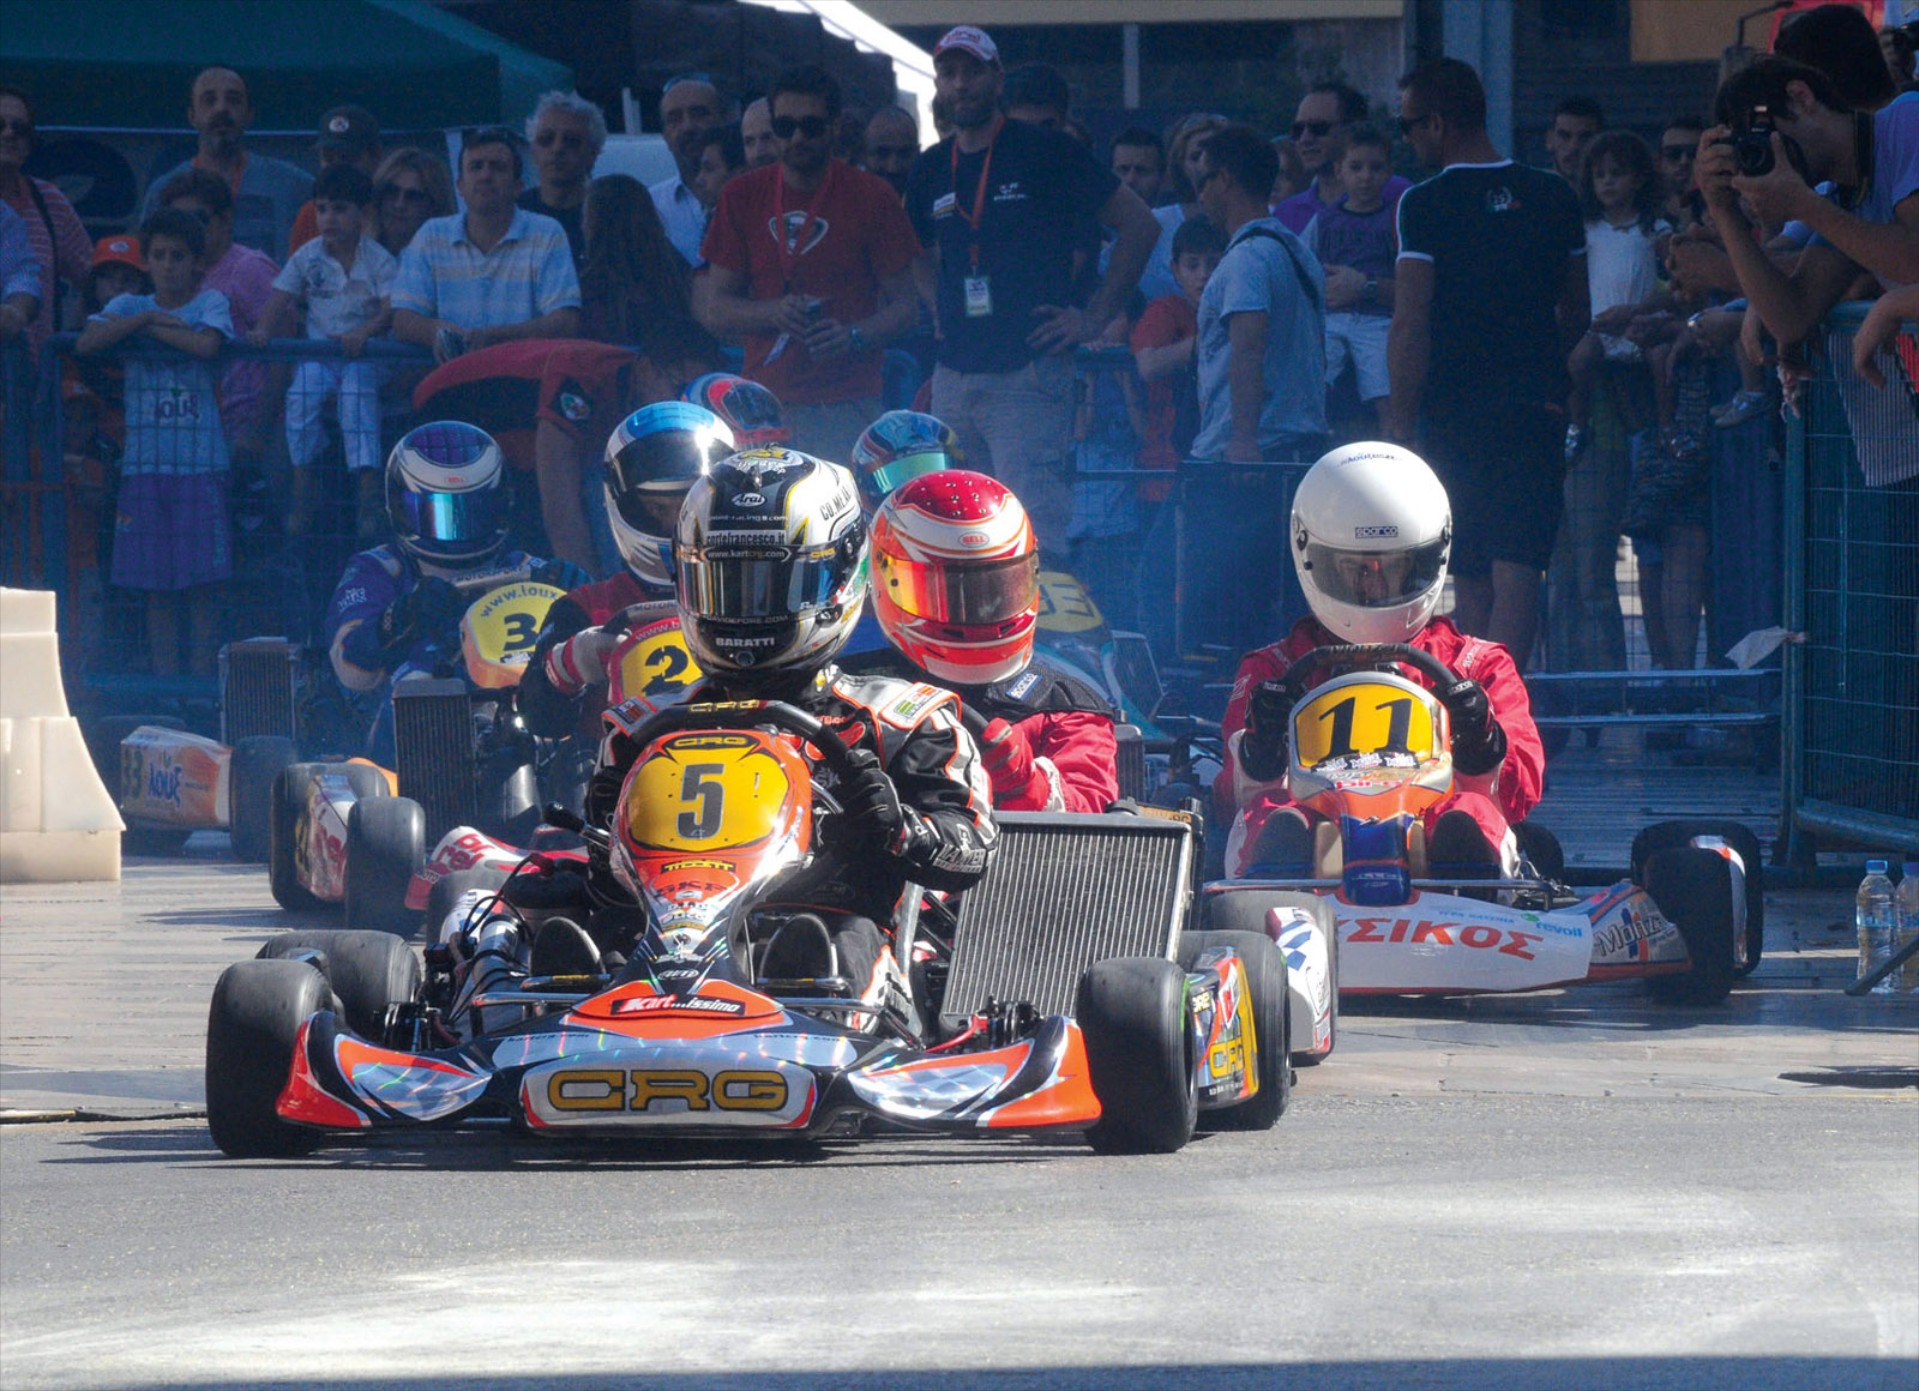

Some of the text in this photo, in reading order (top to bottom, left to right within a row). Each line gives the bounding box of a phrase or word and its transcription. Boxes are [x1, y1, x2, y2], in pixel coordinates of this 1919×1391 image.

[731, 493, 765, 507] Arai
[962, 535, 985, 544] BELL
[1356, 526, 1398, 538] sparco
[715, 637, 775, 647] BARATTI
[642, 644, 689, 697] 2
[1318, 696, 1415, 764] 11
[674, 736, 748, 748] CRG
[676, 763, 725, 840] 5
[1536, 921, 1582, 938] revoil
[547, 1070, 789, 1111] CRG
